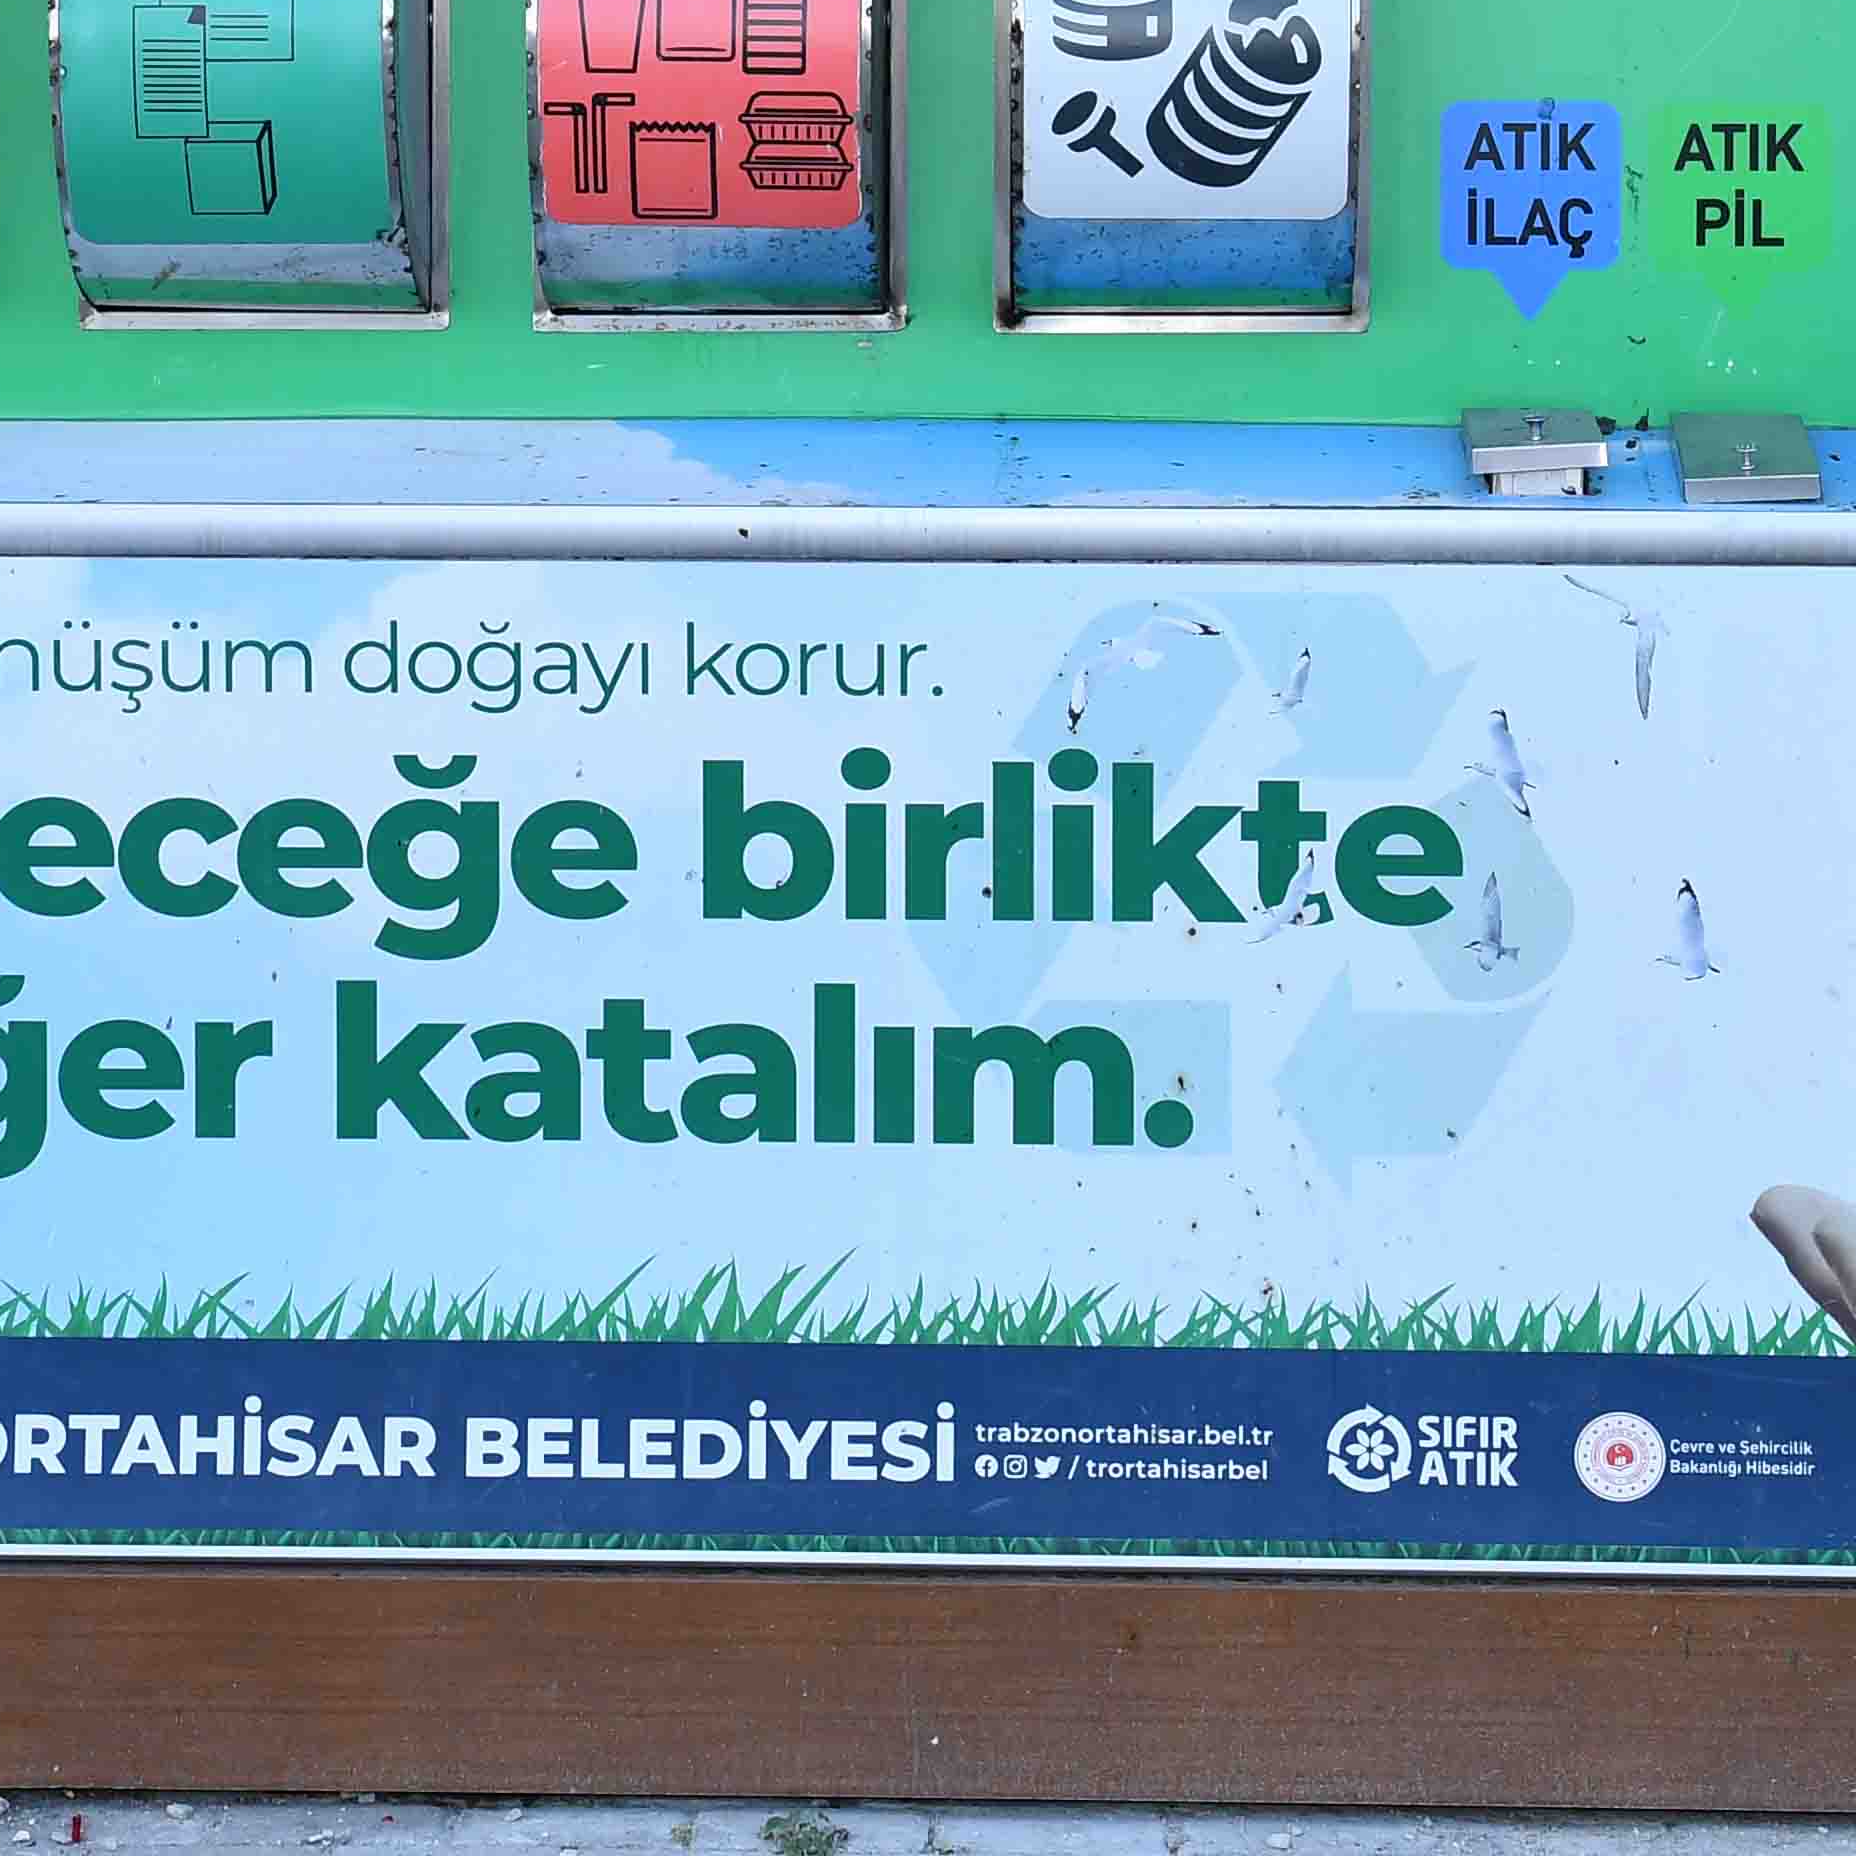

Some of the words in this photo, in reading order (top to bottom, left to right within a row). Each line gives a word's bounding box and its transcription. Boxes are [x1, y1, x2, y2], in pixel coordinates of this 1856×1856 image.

[1463, 122, 1597, 172] ATIK
[1673, 123, 1805, 172] ATIK
[1467, 187, 1594, 259] İLAÇ
[1695, 188, 1785, 247] PİL
[344, 619, 650, 715] doğayı
[685, 621, 946, 697] korur.
[700, 746, 1464, 926] birlikte
[335, 979, 1195, 1150] katalım.
[465, 1399, 955, 1482] BELEDİYESİ
[975, 1422, 1274, 1446] trabzonortahisar.bel.tr
[1418, 1415, 1519, 1449] SIFIR
[1670, 1438, 1715, 1456] Çevre
[1718, 1443, 1737, 1455] ve
[1739, 1439, 1814, 1456] Şehircilik
[1085, 1457, 1269, 1481] trortahisarbel
[1418, 1451, 1519, 1487] ATIK
[1669, 1459, 1742, 1478] Bakanlığı
[1745, 1460, 1816, 1477] Hibesidir
